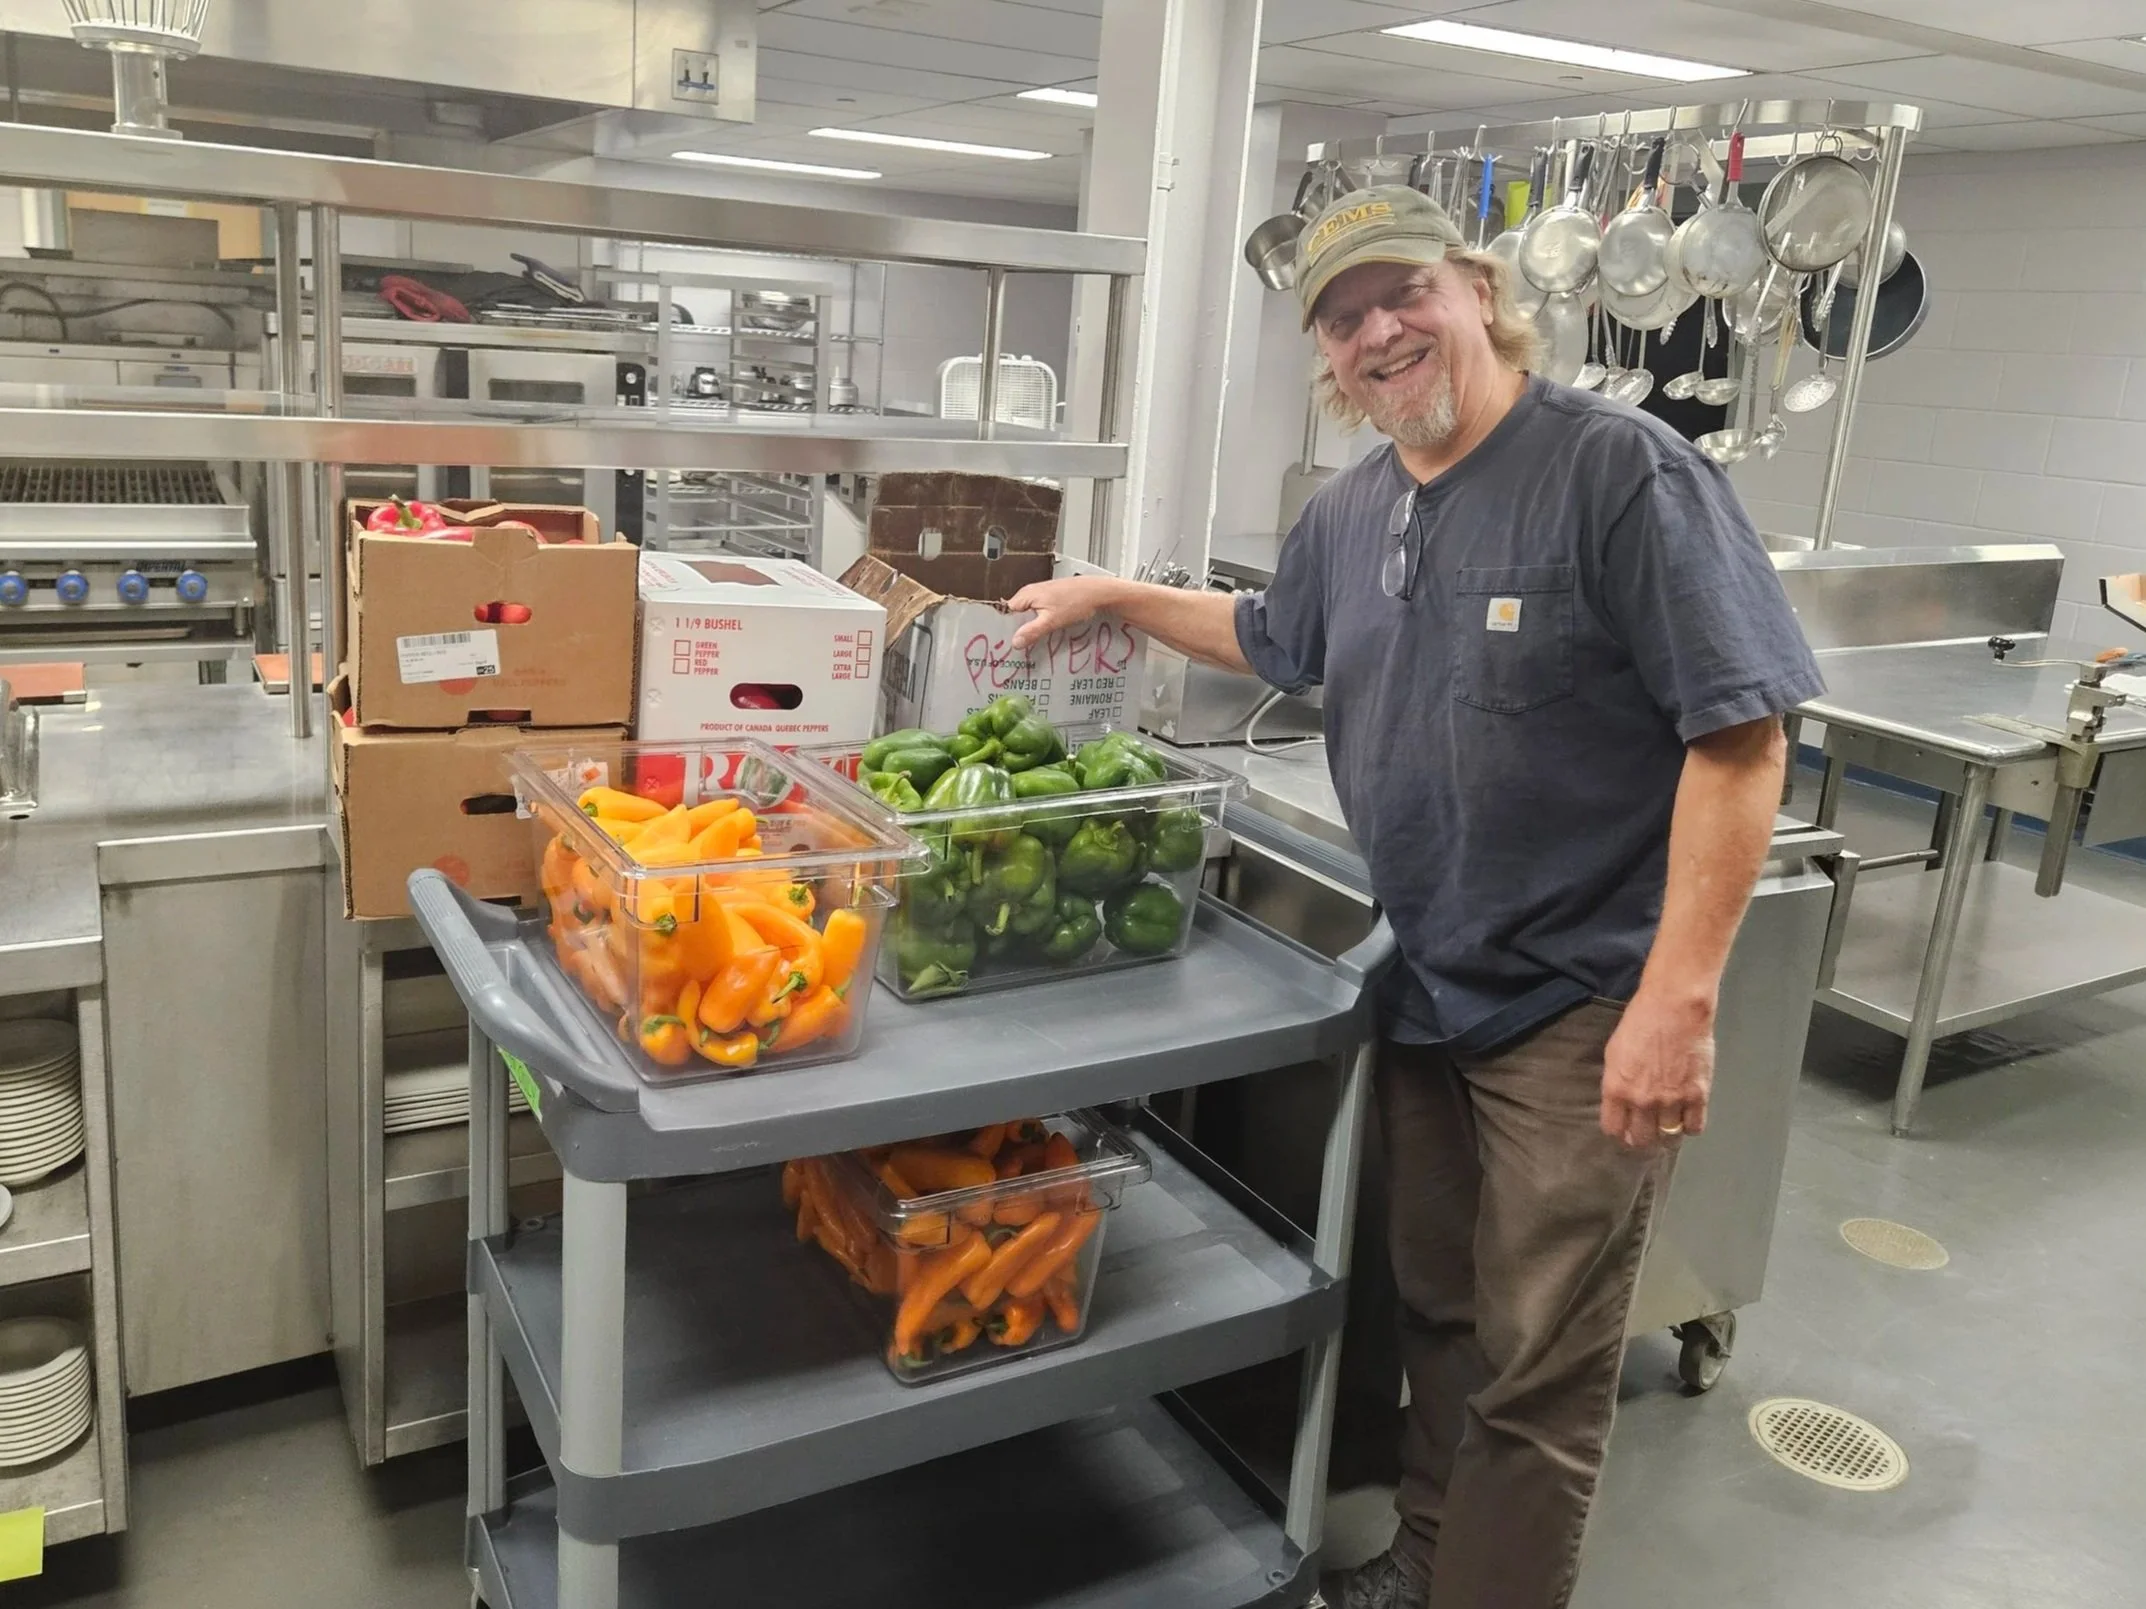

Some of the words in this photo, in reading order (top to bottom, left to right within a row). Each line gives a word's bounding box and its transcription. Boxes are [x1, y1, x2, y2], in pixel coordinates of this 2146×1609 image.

[675, 617, 680, 628] 1
[686, 617, 701, 629] 1/9
[704, 618, 743, 631] BUSHEL
[834, 634, 853, 643] SMALL
[695, 641, 717, 650] GREEN
[695, 650, 719, 658] PEPPER
[833, 650, 852, 658] LARGE
[694, 658, 707, 667] RED
[694, 667, 718, 675] PEPPER
[833, 663, 852, 672] EXTRA
[832, 672, 851, 680] LARGE
[1003, 679, 1037, 690] BEANS
[1070, 678, 1093, 690] LEAF
[1096, 677, 1114, 689] RED
[1070, 692, 1112, 706] ROMAINE
[1088, 707, 1110, 719] LEAF
[700, 723, 732, 732] PRODUCT
[734, 723, 743, 732] OF
[745, 724, 772, 733] CANADA
[775, 724, 801, 733] QUEBEC
[802, 724, 829, 733] PEPPERS
